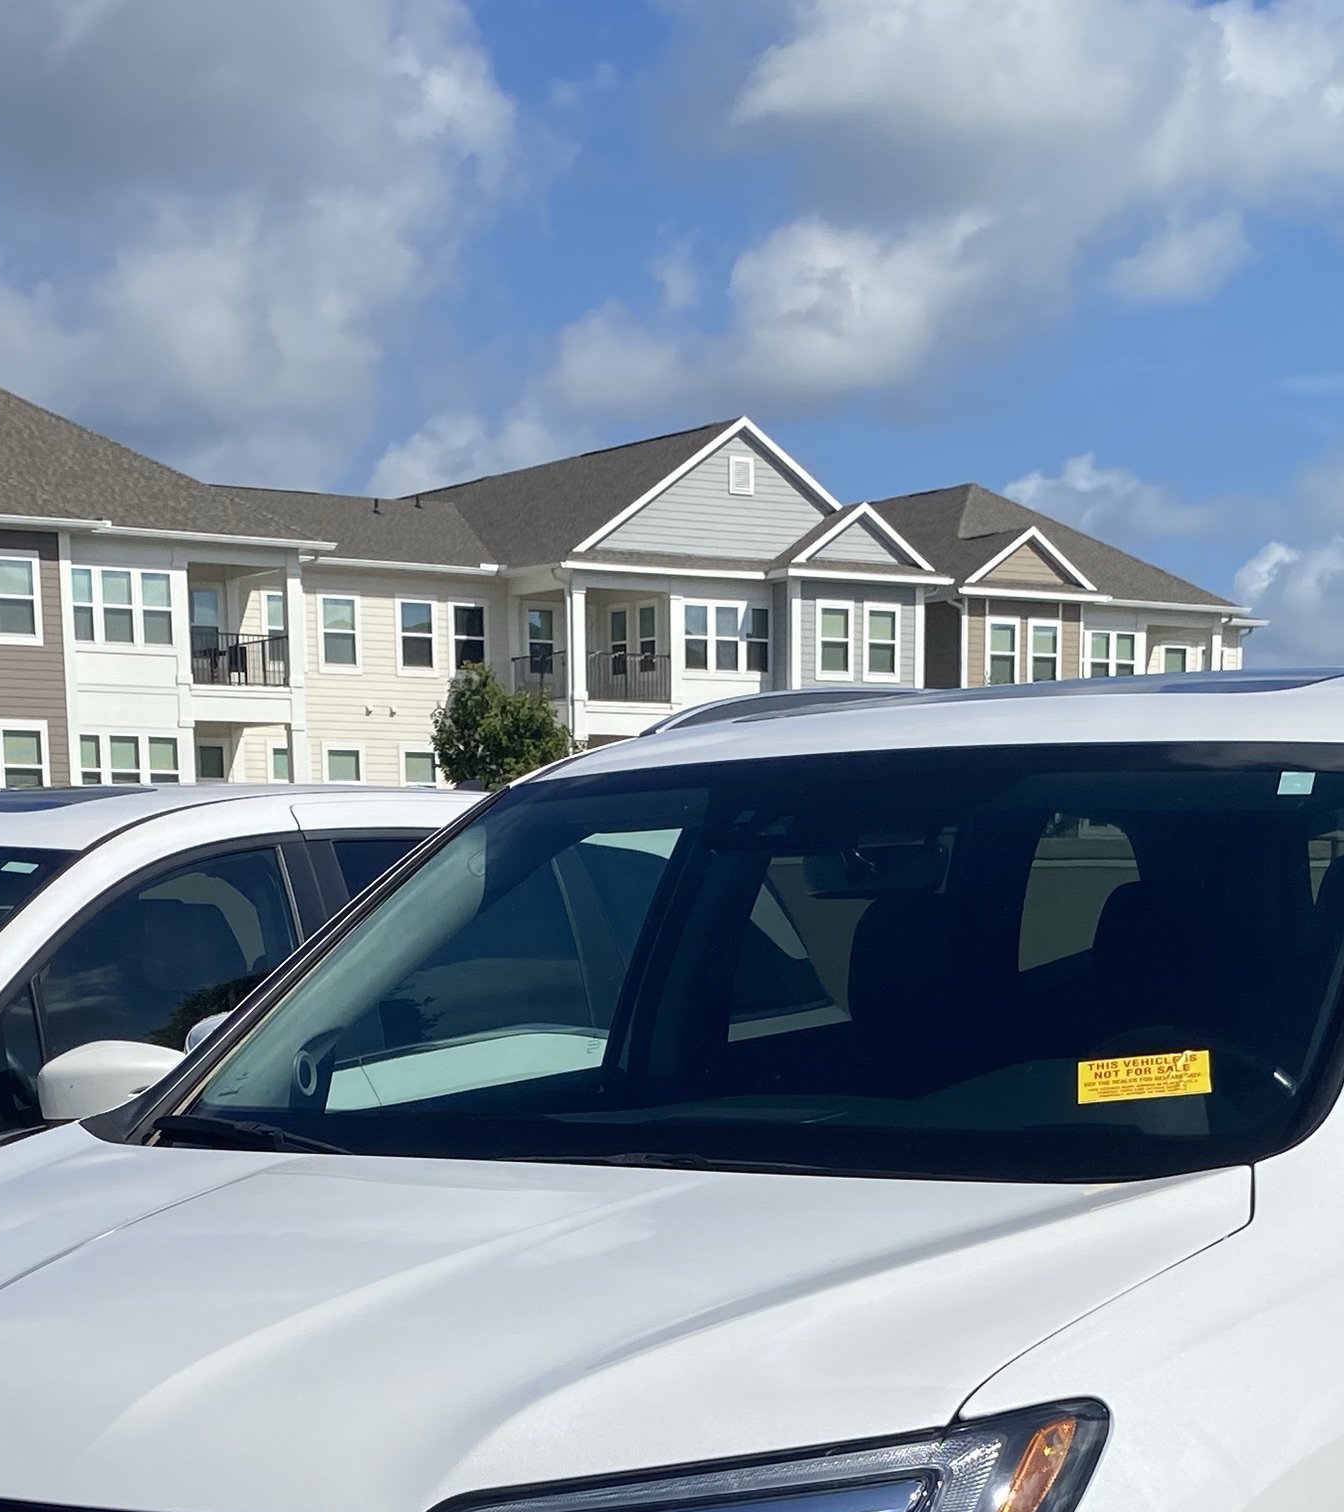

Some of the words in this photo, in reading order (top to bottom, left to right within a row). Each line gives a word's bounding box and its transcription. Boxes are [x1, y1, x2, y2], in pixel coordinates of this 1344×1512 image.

[1087, 1060, 1119, 1071] THIS
[1123, 1055, 1180, 1068] VEHICLE
[1185, 1053, 1197, 1062] IS
[1094, 1069, 1120, 1080] NOT
[1126, 1066, 1152, 1077] FOR
[1157, 1063, 1191, 1074] SALE
